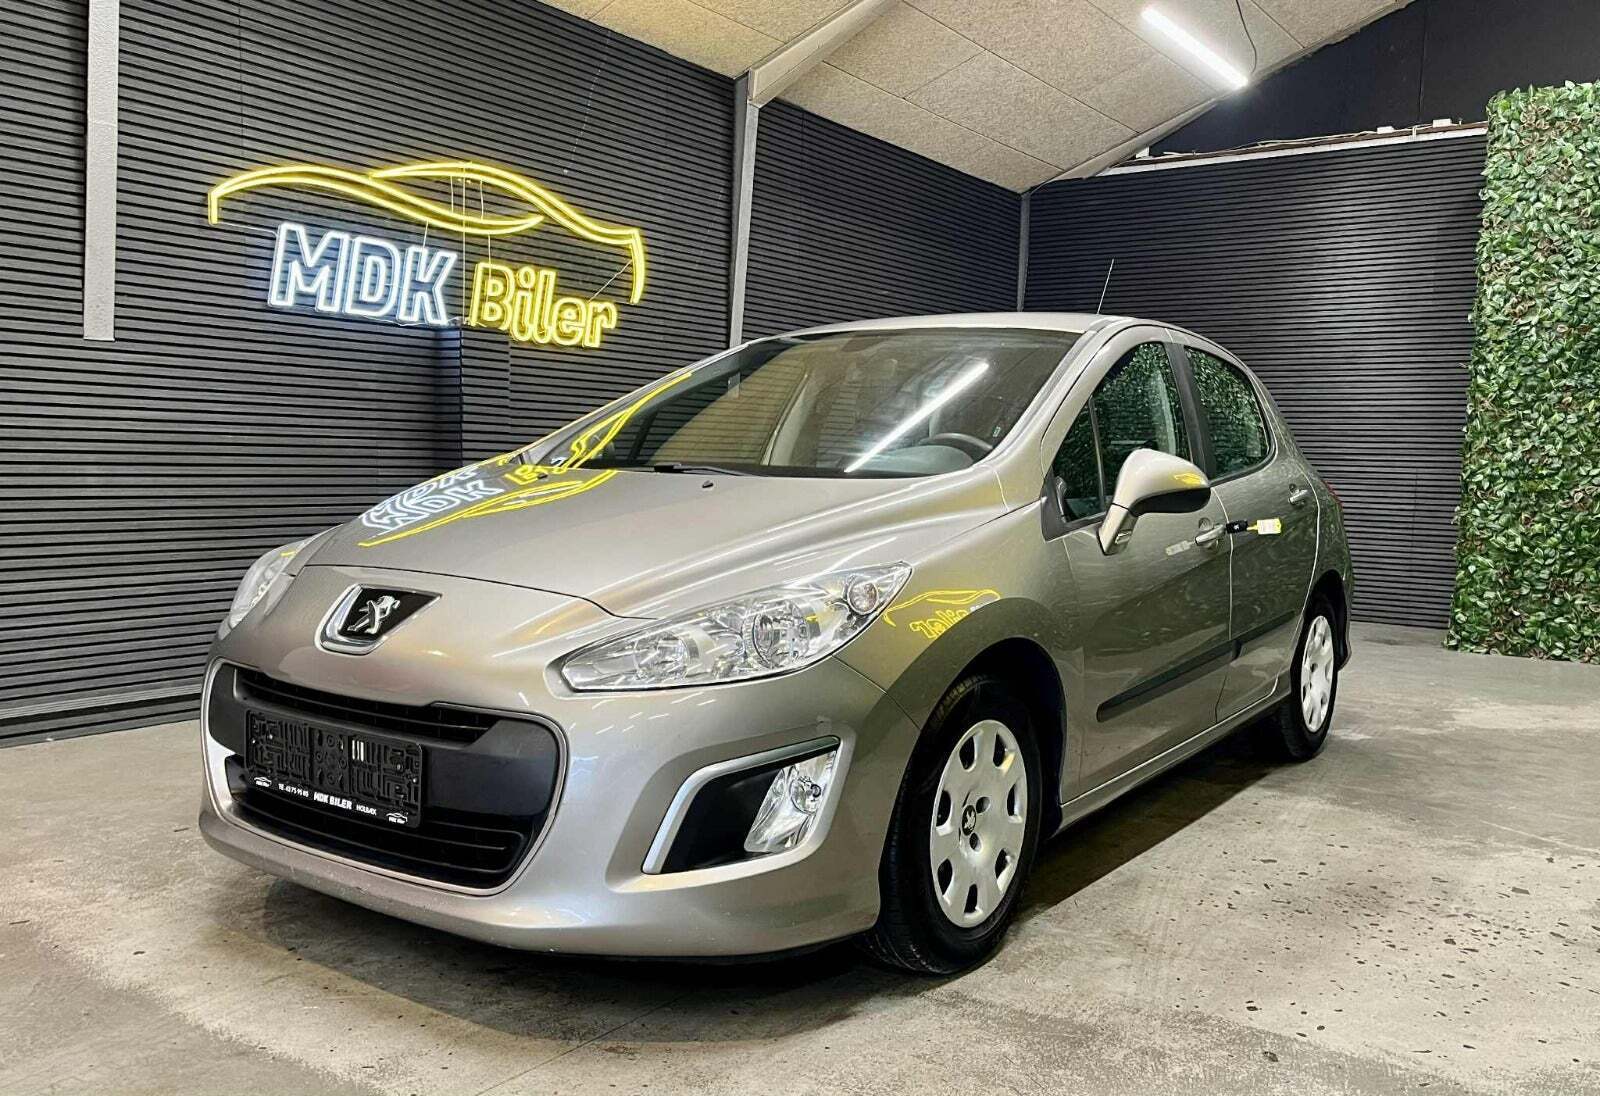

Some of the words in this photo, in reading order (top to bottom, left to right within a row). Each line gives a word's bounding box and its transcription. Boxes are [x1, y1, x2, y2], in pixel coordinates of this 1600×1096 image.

[267, 222, 457, 326] MDK
[469, 262, 617, 348] Biler
[313, 791, 329, 804] MDK
[329, 795, 353, 810] BILER
